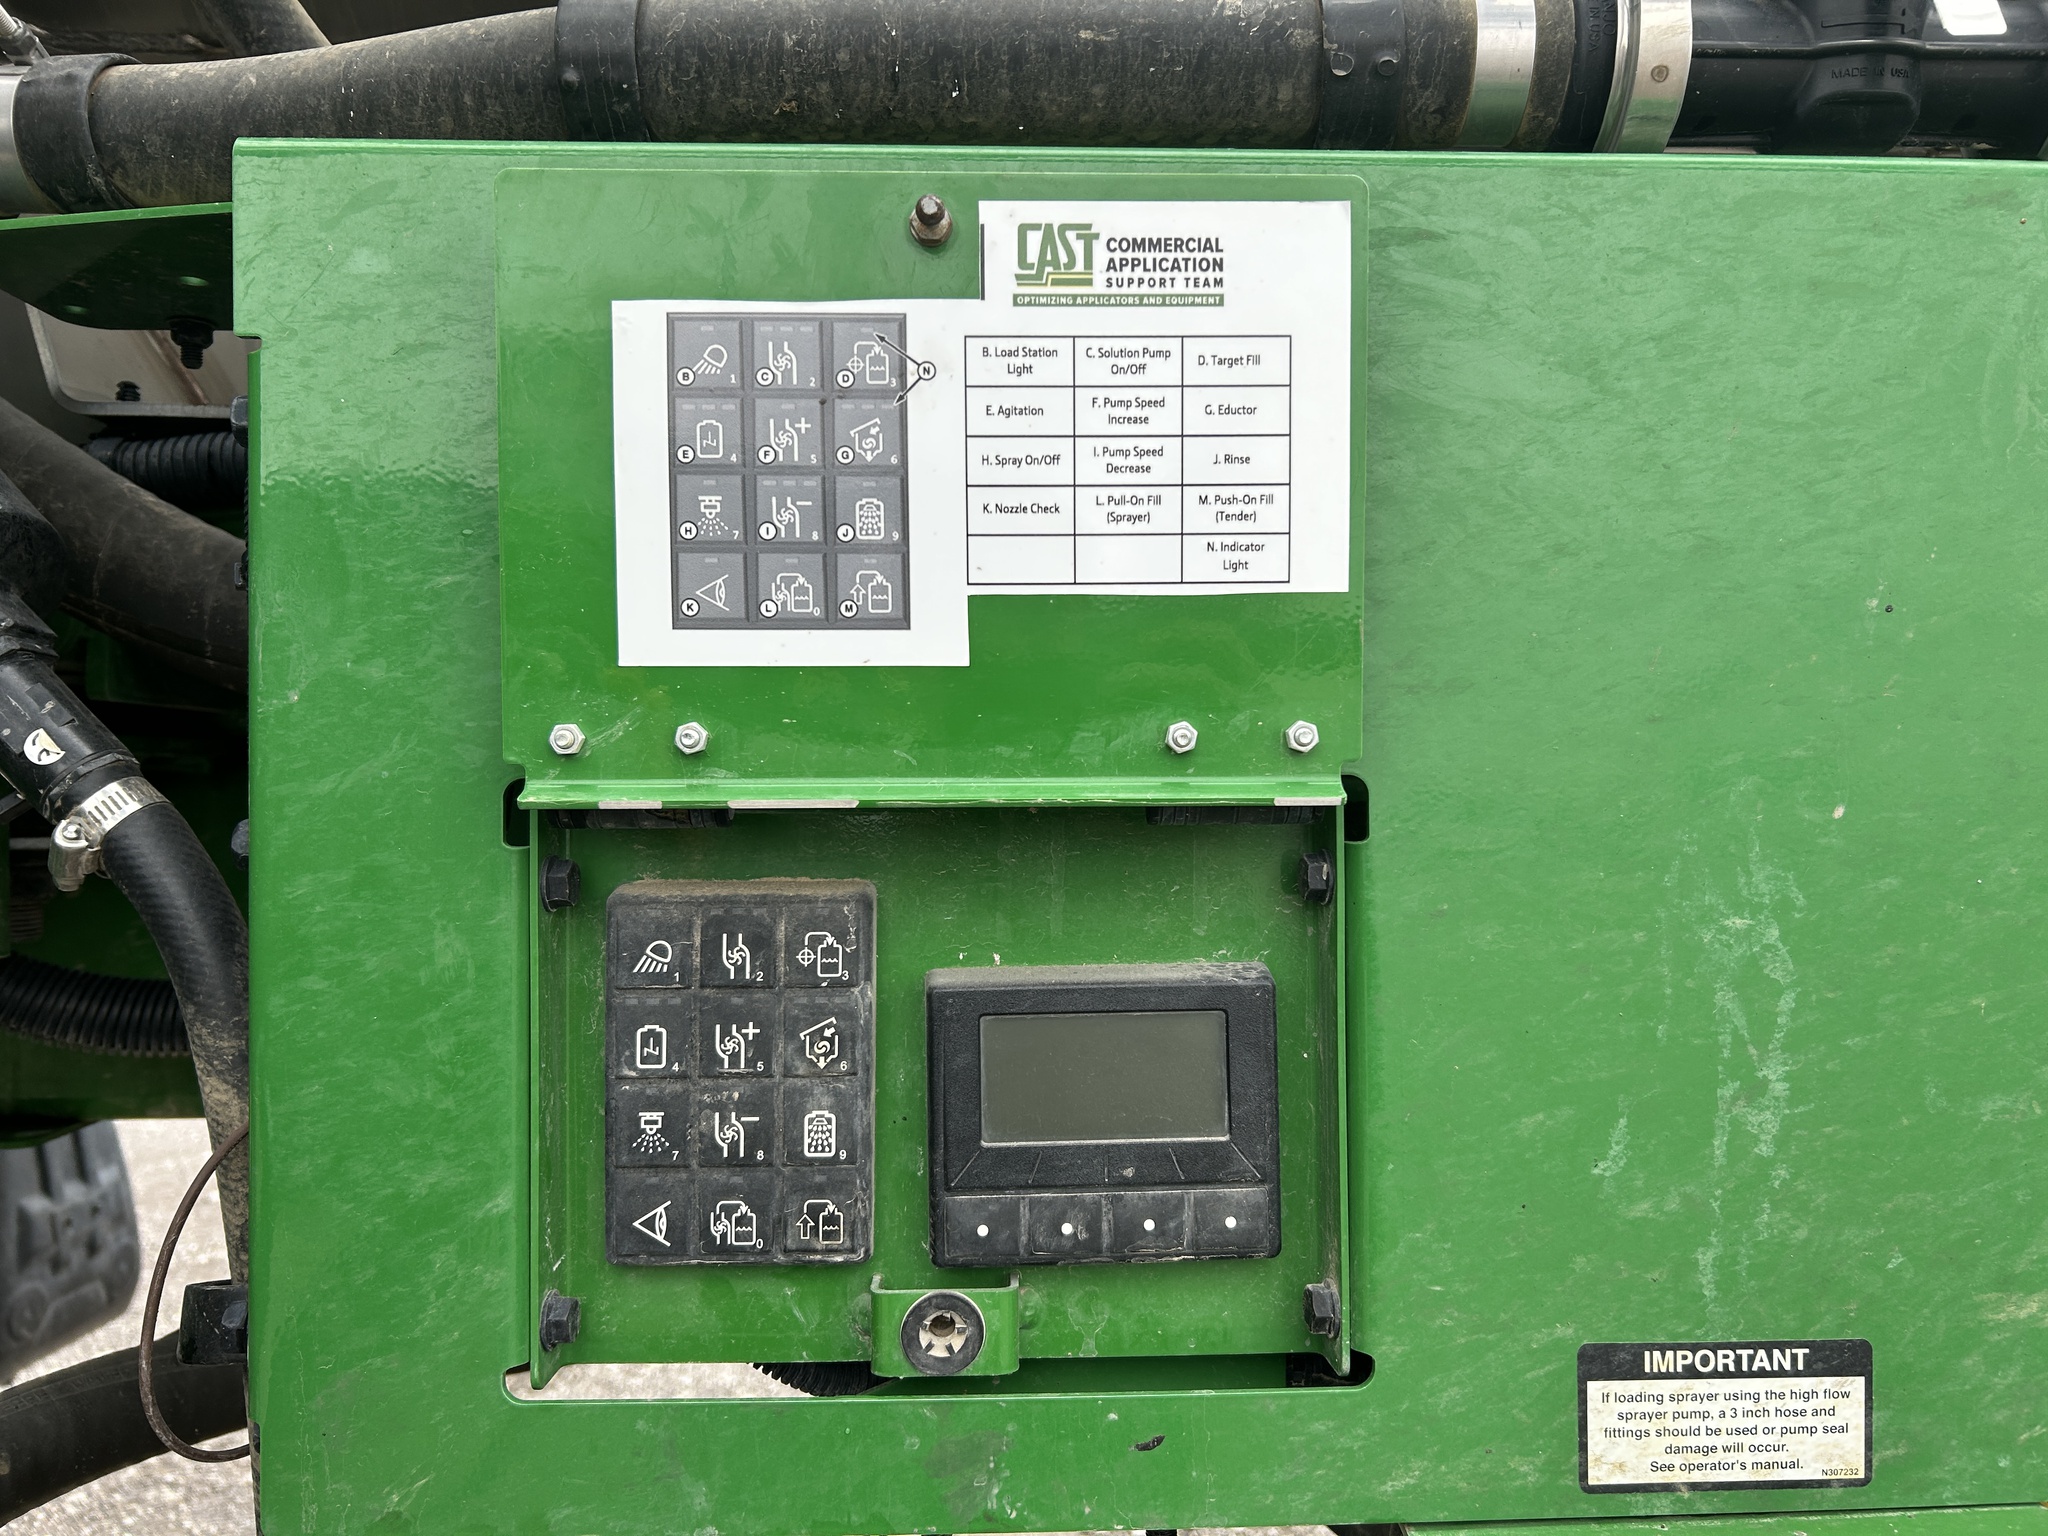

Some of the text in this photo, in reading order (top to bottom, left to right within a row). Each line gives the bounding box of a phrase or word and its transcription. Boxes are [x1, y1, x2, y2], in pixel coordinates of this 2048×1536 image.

[1588, 24, 1600, 52] USA
[1017, 223, 1100, 271] CAST
[1106, 237, 1223, 253] COMMERCIAL
[1106, 258, 1224, 272] APPLICATION
[1106, 277, 1224, 288] SUPPORT TEAM
[1017, 296, 1220, 305] OPTIMIZING APPLICATORS AND EQUIPMENT
[983, 347, 1058, 358] B. Load Station
[1086, 347, 1171, 361] C. Solution Pump
[1199, 355, 1260, 368] D. Target Fill
[923, 367, 930, 375] N
[1007, 363, 1033, 375] Light
[1111, 363, 1146, 375] On/Off
[683, 372, 689, 381] B
[730, 375, 736, 383] 1
[761, 372, 769, 381] C
[842, 375, 850, 383] D
[810, 378, 816, 386] 2
[890, 378, 896, 387] 3
[1092, 397, 1165, 411] F. Pump Speed
[986, 405, 1044, 418] E. Agitation
[1205, 404, 1257, 415] G. Eductor
[1108, 414, 1149, 425] Increase
[683, 450, 689, 458] E
[764, 450, 770, 458] F
[842, 451, 849, 460] G
[1093, 446, 1163, 459] I. Pump Speed
[730, 454, 736, 462] 4
[811, 455, 816, 463] 5
[891, 455, 897, 464] 6
[982, 455, 1060, 467] H. Spray On/Off
[1213, 454, 1250, 466] J. Rinse
[1106, 463, 1151, 474] Decrease
[1096, 495, 1161, 506] L. Pull-On Fill
[1200, 495, 1274, 506] M. Push-On Fill
[983, 503, 1060, 515] K. Nozzle Check
[1107, 512, 1151, 524] (Sprayer)
[1215, 511, 1257, 523] (Tender)
[685, 527, 692, 535] H
[733, 531, 739, 539] 7
[766, 527, 769, 535] I
[842, 528, 848, 537] J
[812, 532, 818, 540] 8
[892, 532, 898, 540] 9
[1207, 542, 1265, 552] N. Indicator
[1223, 560, 1248, 573] Light
[687, 603, 694, 612] K
[766, 604, 771, 612] L
[814, 607, 820, 616] 0
[844, 604, 853, 612] M
[674, 972, 679, 981] 1
[757, 972, 763, 981] 2
[842, 971, 849, 980] 3
[672, 1063, 679, 1071] 4
[757, 1062, 764, 1071] 5
[840, 1061, 847, 1070] 6
[672, 1151, 679, 1160] 7
[757, 1151, 764, 1160] 8
[839, 1150, 846, 1159] 9
[756, 1239, 763, 1248] 0
[1644, 1349, 1809, 1372] IMPORTANT
[1602, 1389, 1850, 1405] If loading sprayer using the high flow
[1618, 1406, 1835, 1422] sprayer pump, a 3 inch hose and
[1604, 1424, 1848, 1440] fittings should be used or pump seal
[1664, 1442, 1789, 1456] damage will occur.
[1650, 1459, 1804, 1474] See operator's manual.
[1822, 1468, 1858, 1476] N307232
